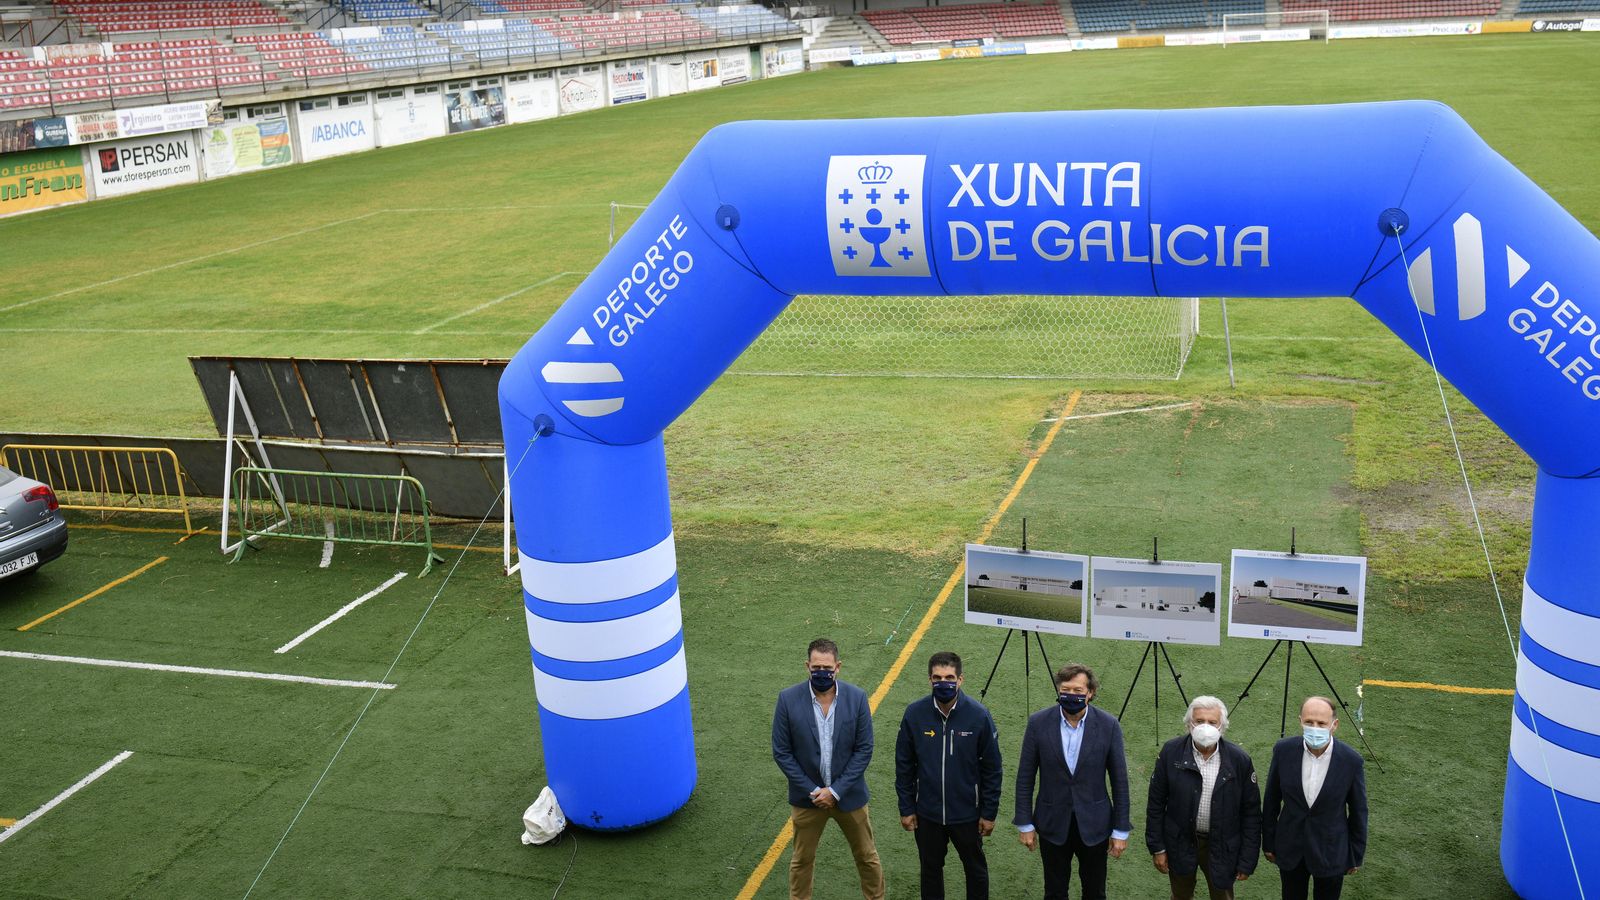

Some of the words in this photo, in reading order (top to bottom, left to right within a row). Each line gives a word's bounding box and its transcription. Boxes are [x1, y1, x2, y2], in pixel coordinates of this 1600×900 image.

[1545, 21, 1582, 31] Autogal
[689, 61, 703, 70] PONTE
[691, 71, 704, 80] VELLA
[80, 113, 105, 122] MONTES
[316, 119, 366, 143] ABANCA
[120, 140, 188, 168] PERSAN
[14, 159, 66, 175] ESCUELA
[102, 164, 191, 185] www.storespersan.com
[947, 161, 1141, 208] XUNTA
[947, 219, 1018, 262] DE
[1031, 219, 1270, 268] GALICIA
[592, 213, 688, 329] DEPORTE
[608, 250, 694, 347] GALEGO
